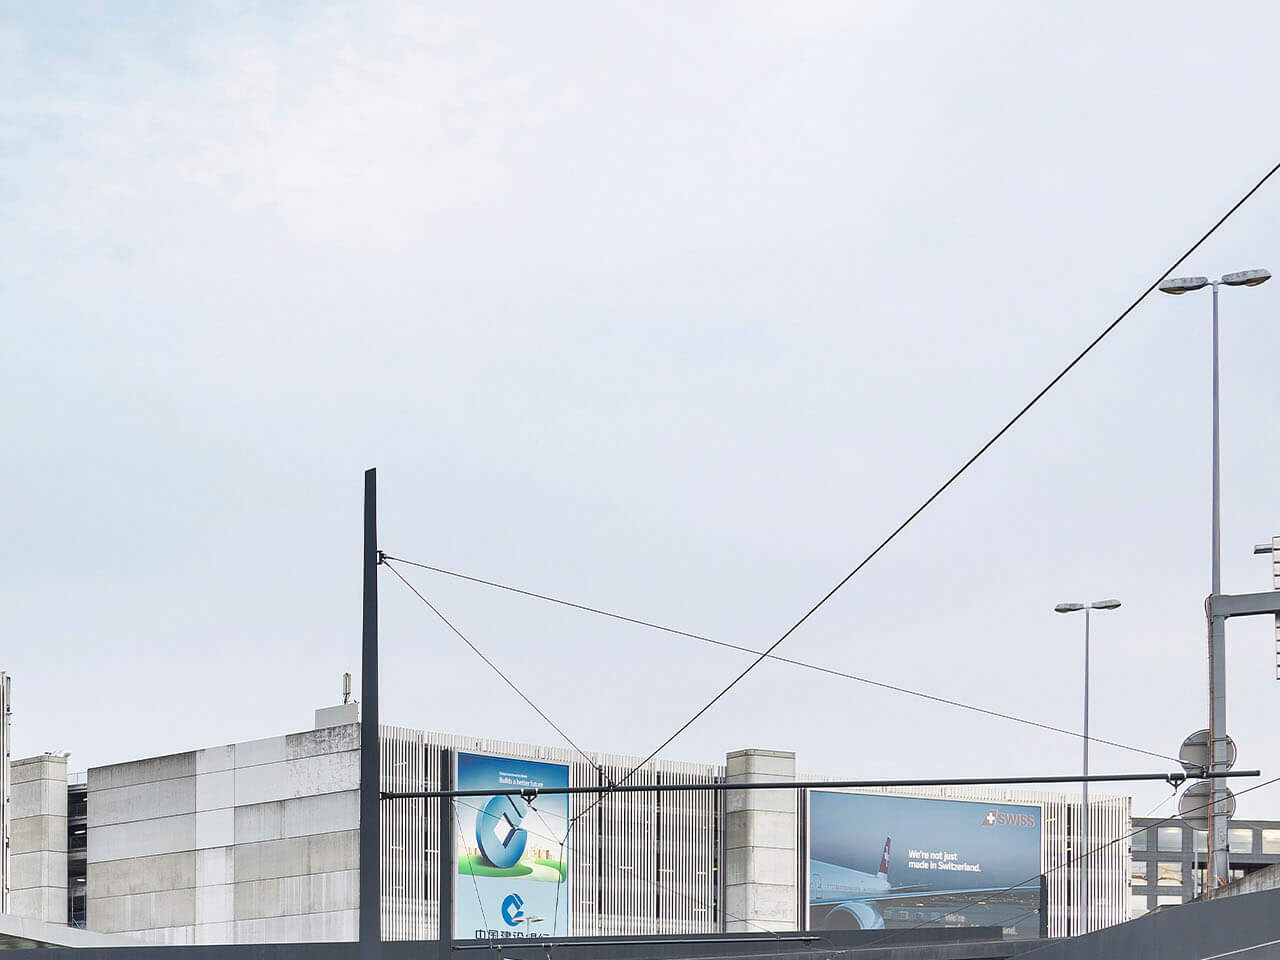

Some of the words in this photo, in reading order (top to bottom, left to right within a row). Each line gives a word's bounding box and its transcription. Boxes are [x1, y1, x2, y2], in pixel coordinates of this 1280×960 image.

[998, 813, 1035, 827] SWISS
[908, 849, 929, 860] We're
[930, 851, 943, 861] not
[943, 852, 958, 863] just
[908, 861, 929, 871] made
[930, 861, 937, 870] in
[938, 861, 982, 873] Switzerland.
